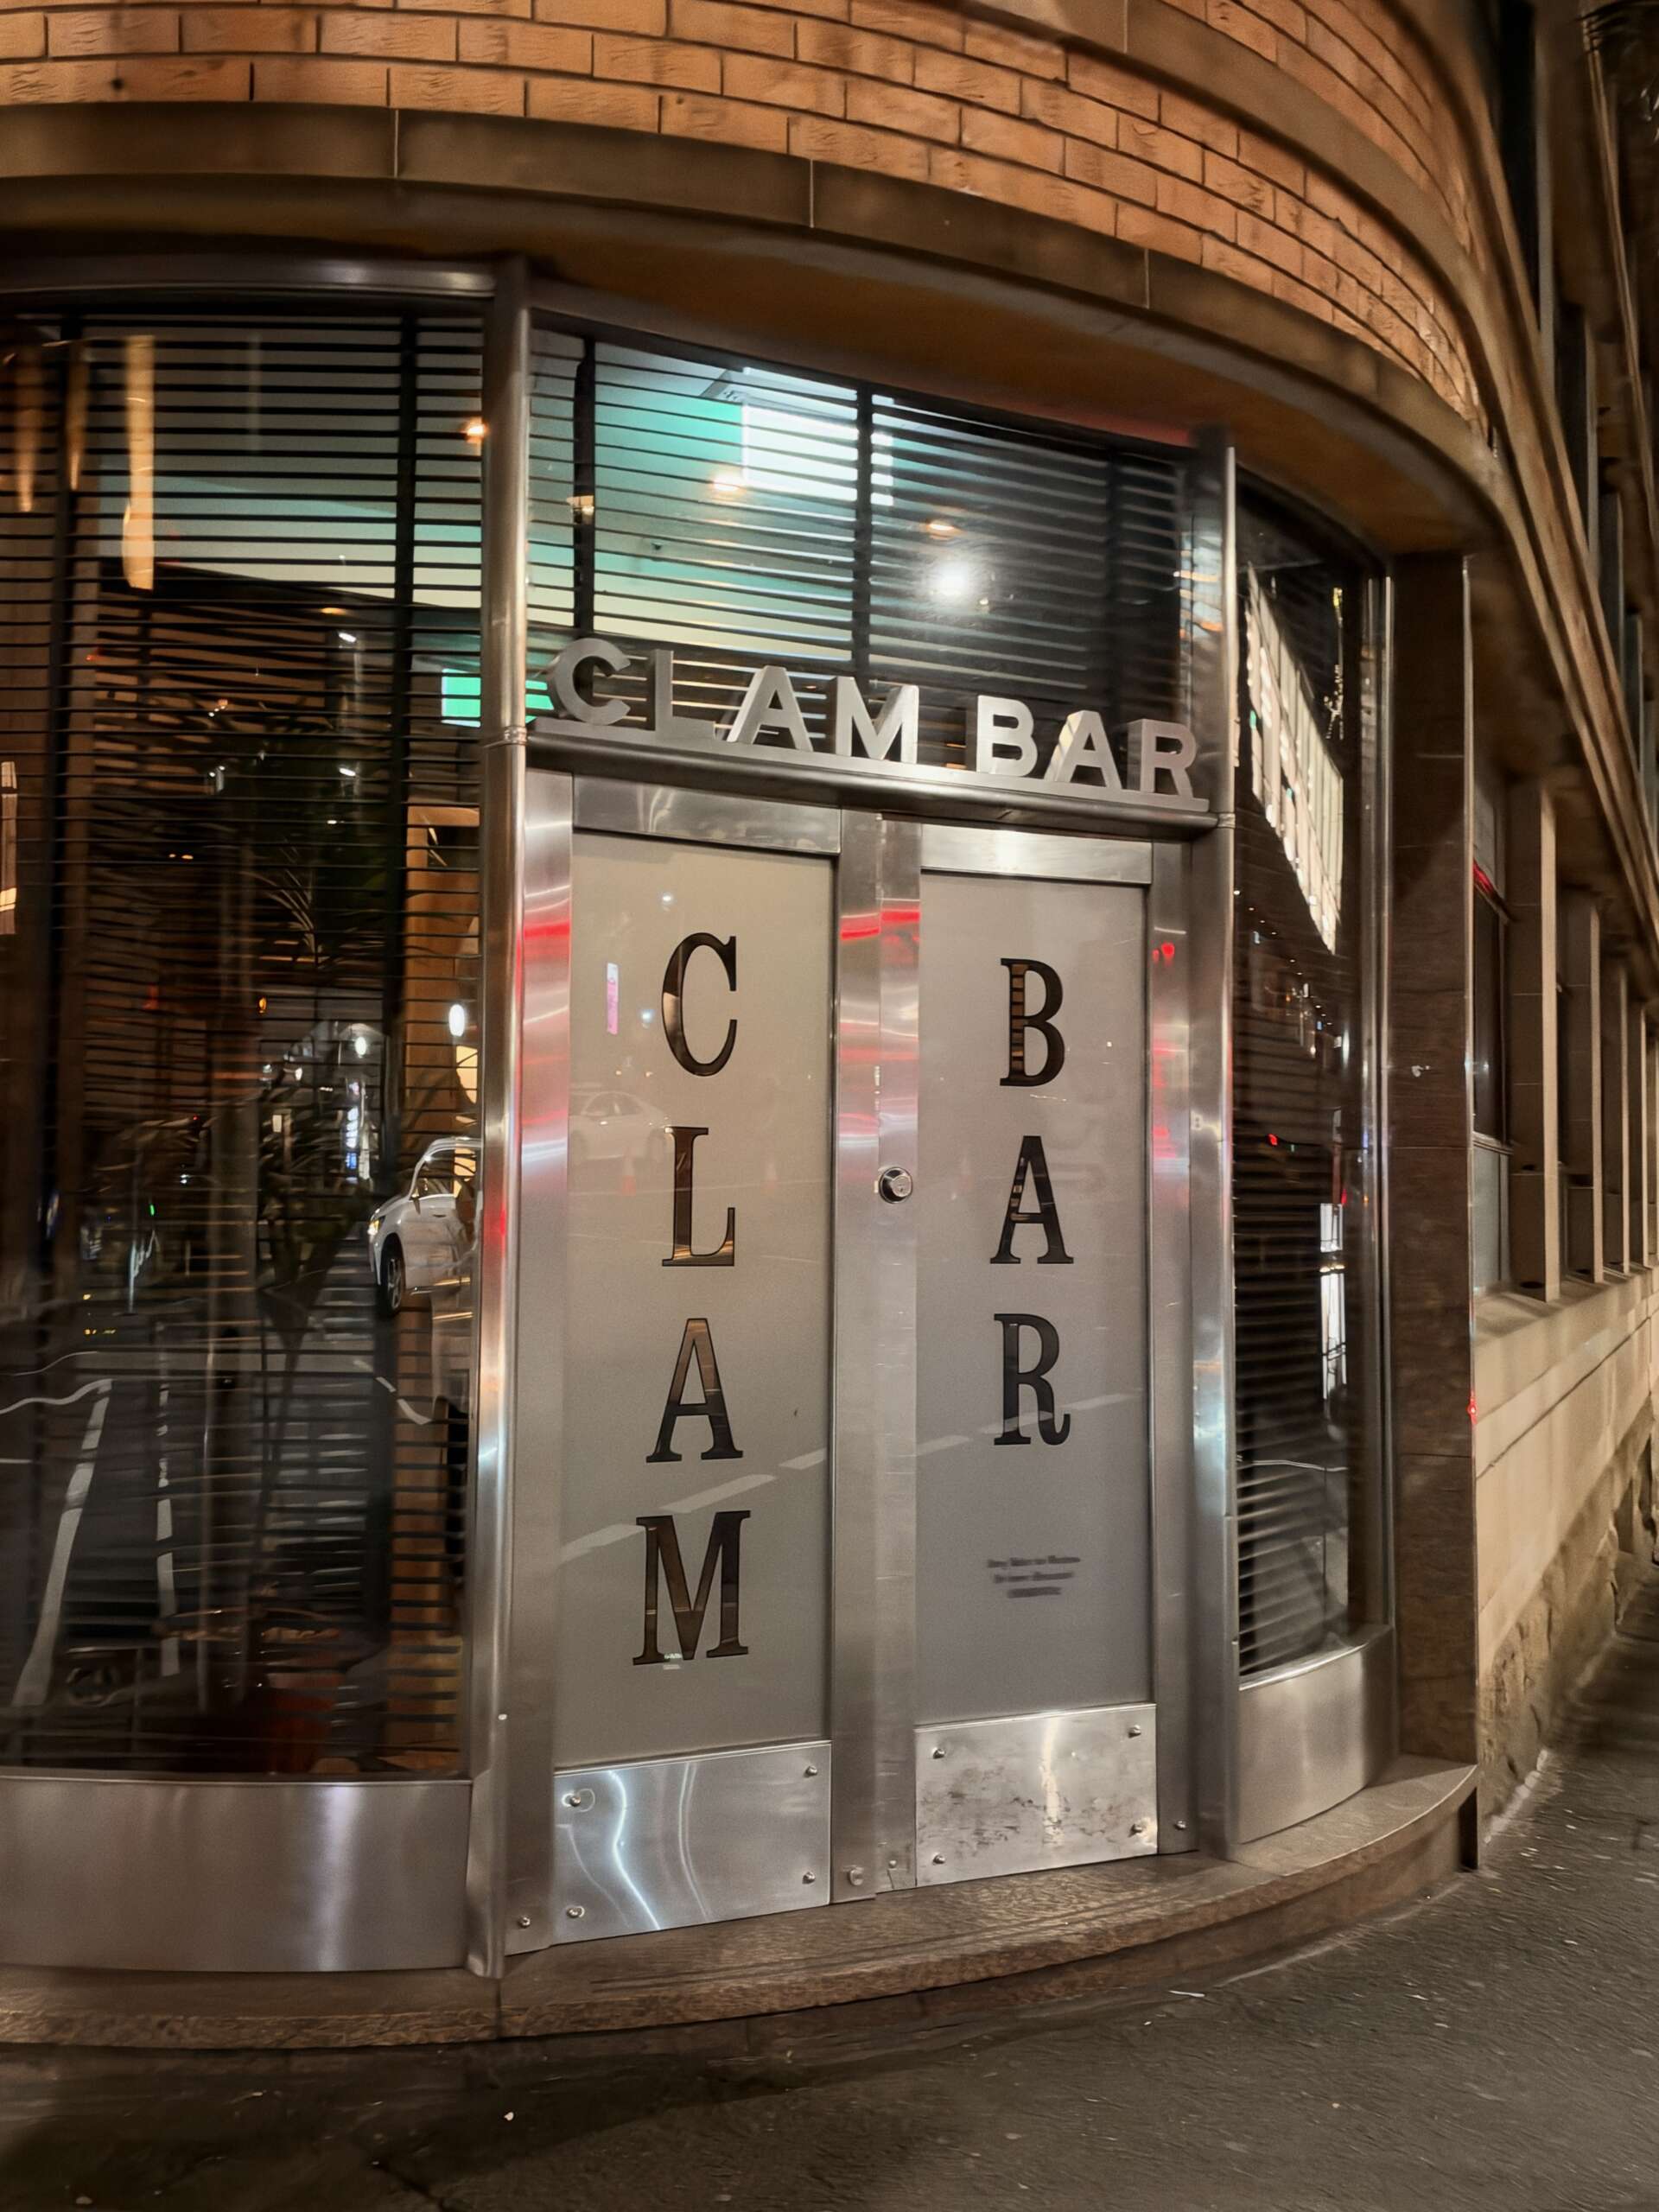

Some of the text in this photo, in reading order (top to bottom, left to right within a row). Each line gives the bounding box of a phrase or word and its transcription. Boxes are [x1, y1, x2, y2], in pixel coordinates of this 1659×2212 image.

[548, 638, 1198, 798] CLAM BAR
[632, 932, 751, 1666] CLAM
[989, 957, 1074, 1446] BAR
